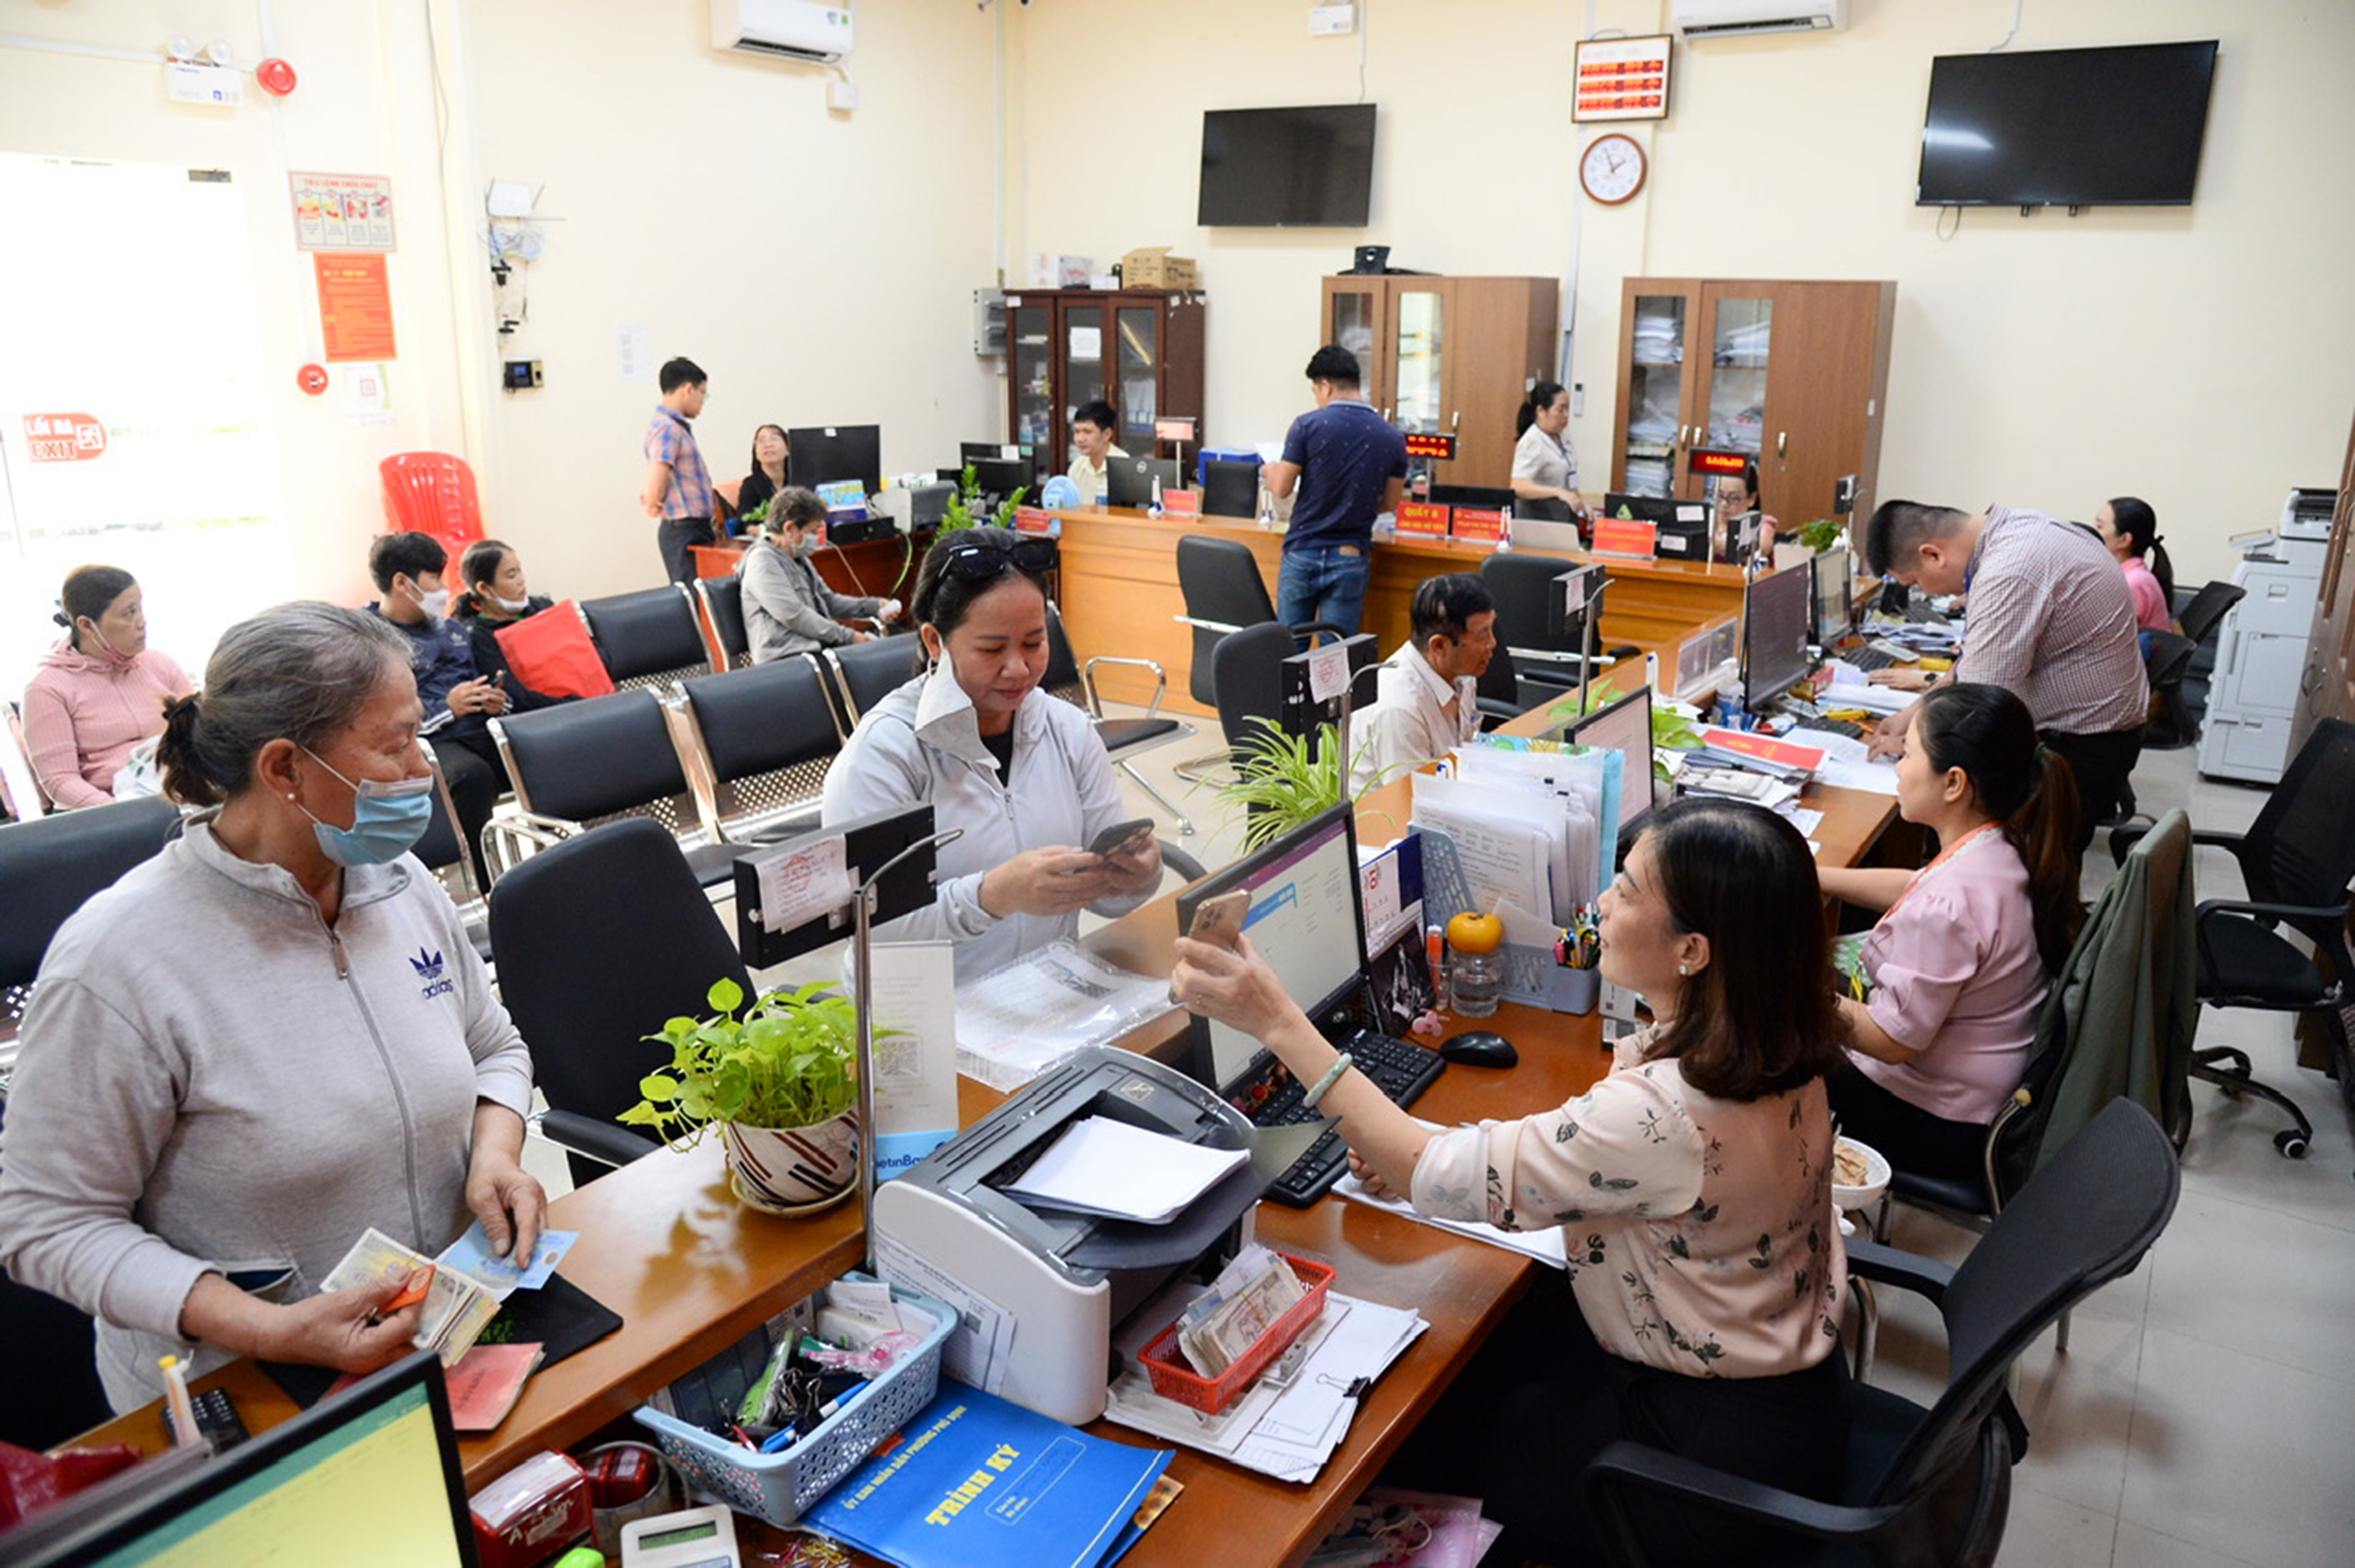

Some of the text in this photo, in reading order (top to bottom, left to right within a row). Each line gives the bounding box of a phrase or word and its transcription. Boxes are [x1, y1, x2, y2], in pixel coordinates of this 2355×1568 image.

[31, 441, 75, 459] EXIT
[924, 1469, 996, 1527] TRÌNH
[985, 1443, 1021, 1472] KÝ
